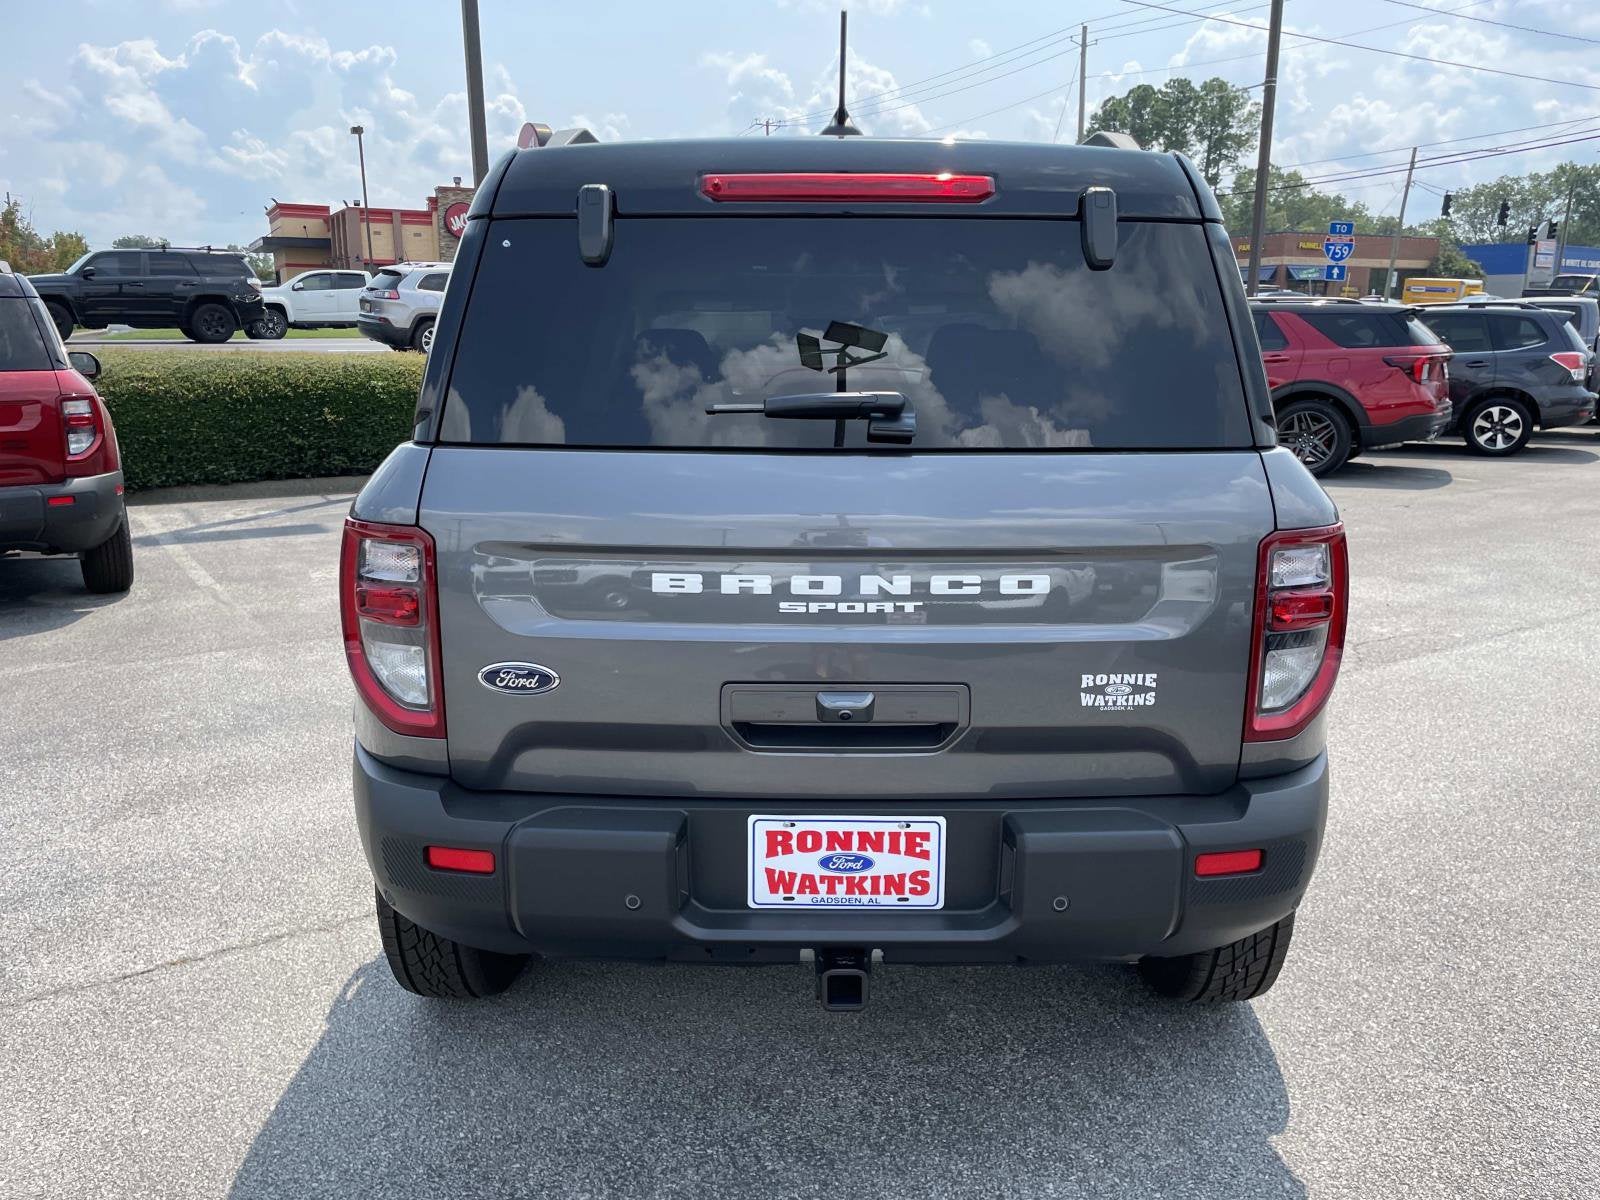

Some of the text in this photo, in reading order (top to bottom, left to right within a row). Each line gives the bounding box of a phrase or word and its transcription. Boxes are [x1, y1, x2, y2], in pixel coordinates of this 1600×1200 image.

[1335, 224, 1348, 233] TO
[1328, 245, 1349, 259] 759
[652, 573, 1051, 596] BRONCO
[779, 601, 923, 614] SPORT
[496, 668, 540, 688] Ford
[1080, 673, 1158, 688] RONNIE
[1080, 691, 1156, 706] WATKINS
[765, 830, 931, 861] RONNIE
[829, 856, 864, 871] Ford
[764, 867, 931, 897] WATKINS
[811, 896, 880, 906] GADSDEN, AL
